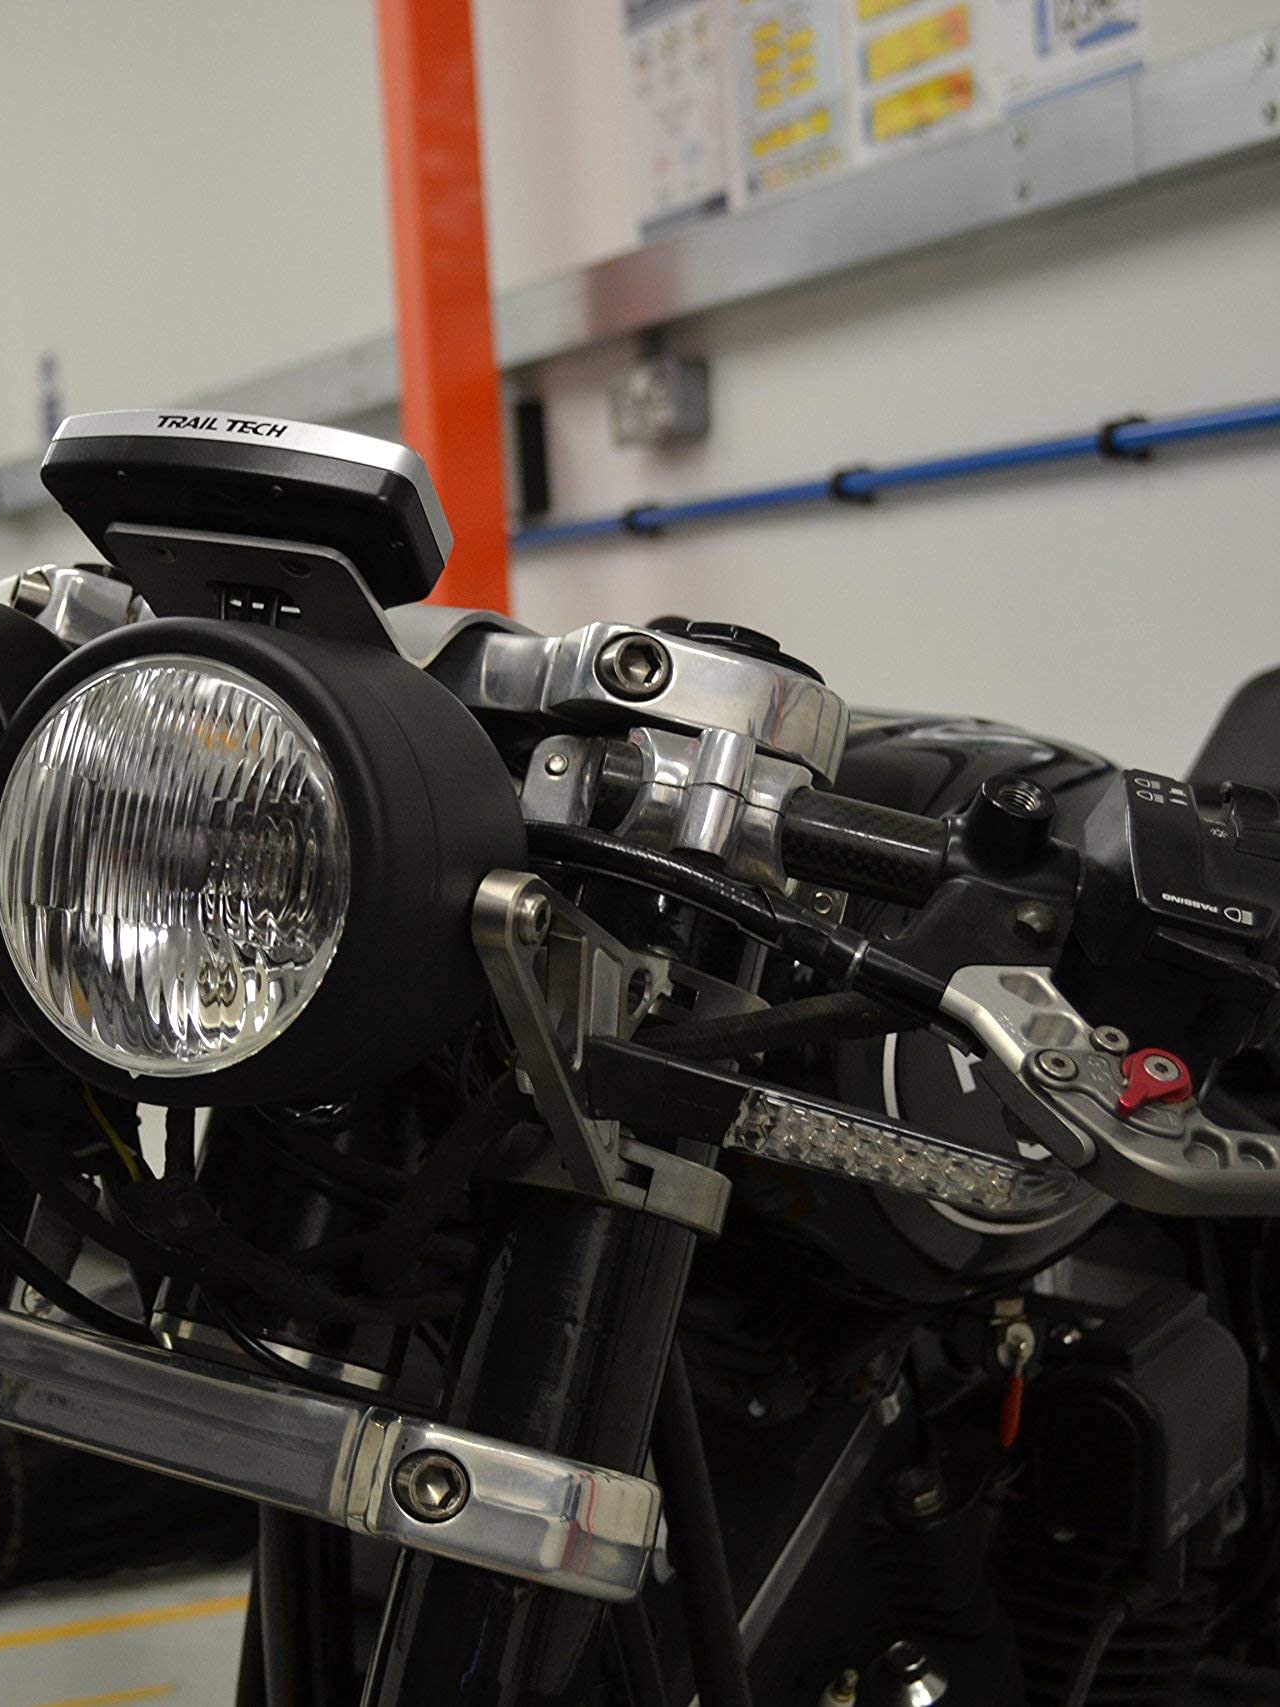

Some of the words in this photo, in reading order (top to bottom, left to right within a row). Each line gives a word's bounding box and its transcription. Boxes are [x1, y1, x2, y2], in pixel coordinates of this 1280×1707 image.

[157, 415, 218, 431] TRAIL
[226, 418, 288, 438] TECH
[1161, 892, 1218, 914] PASSING
